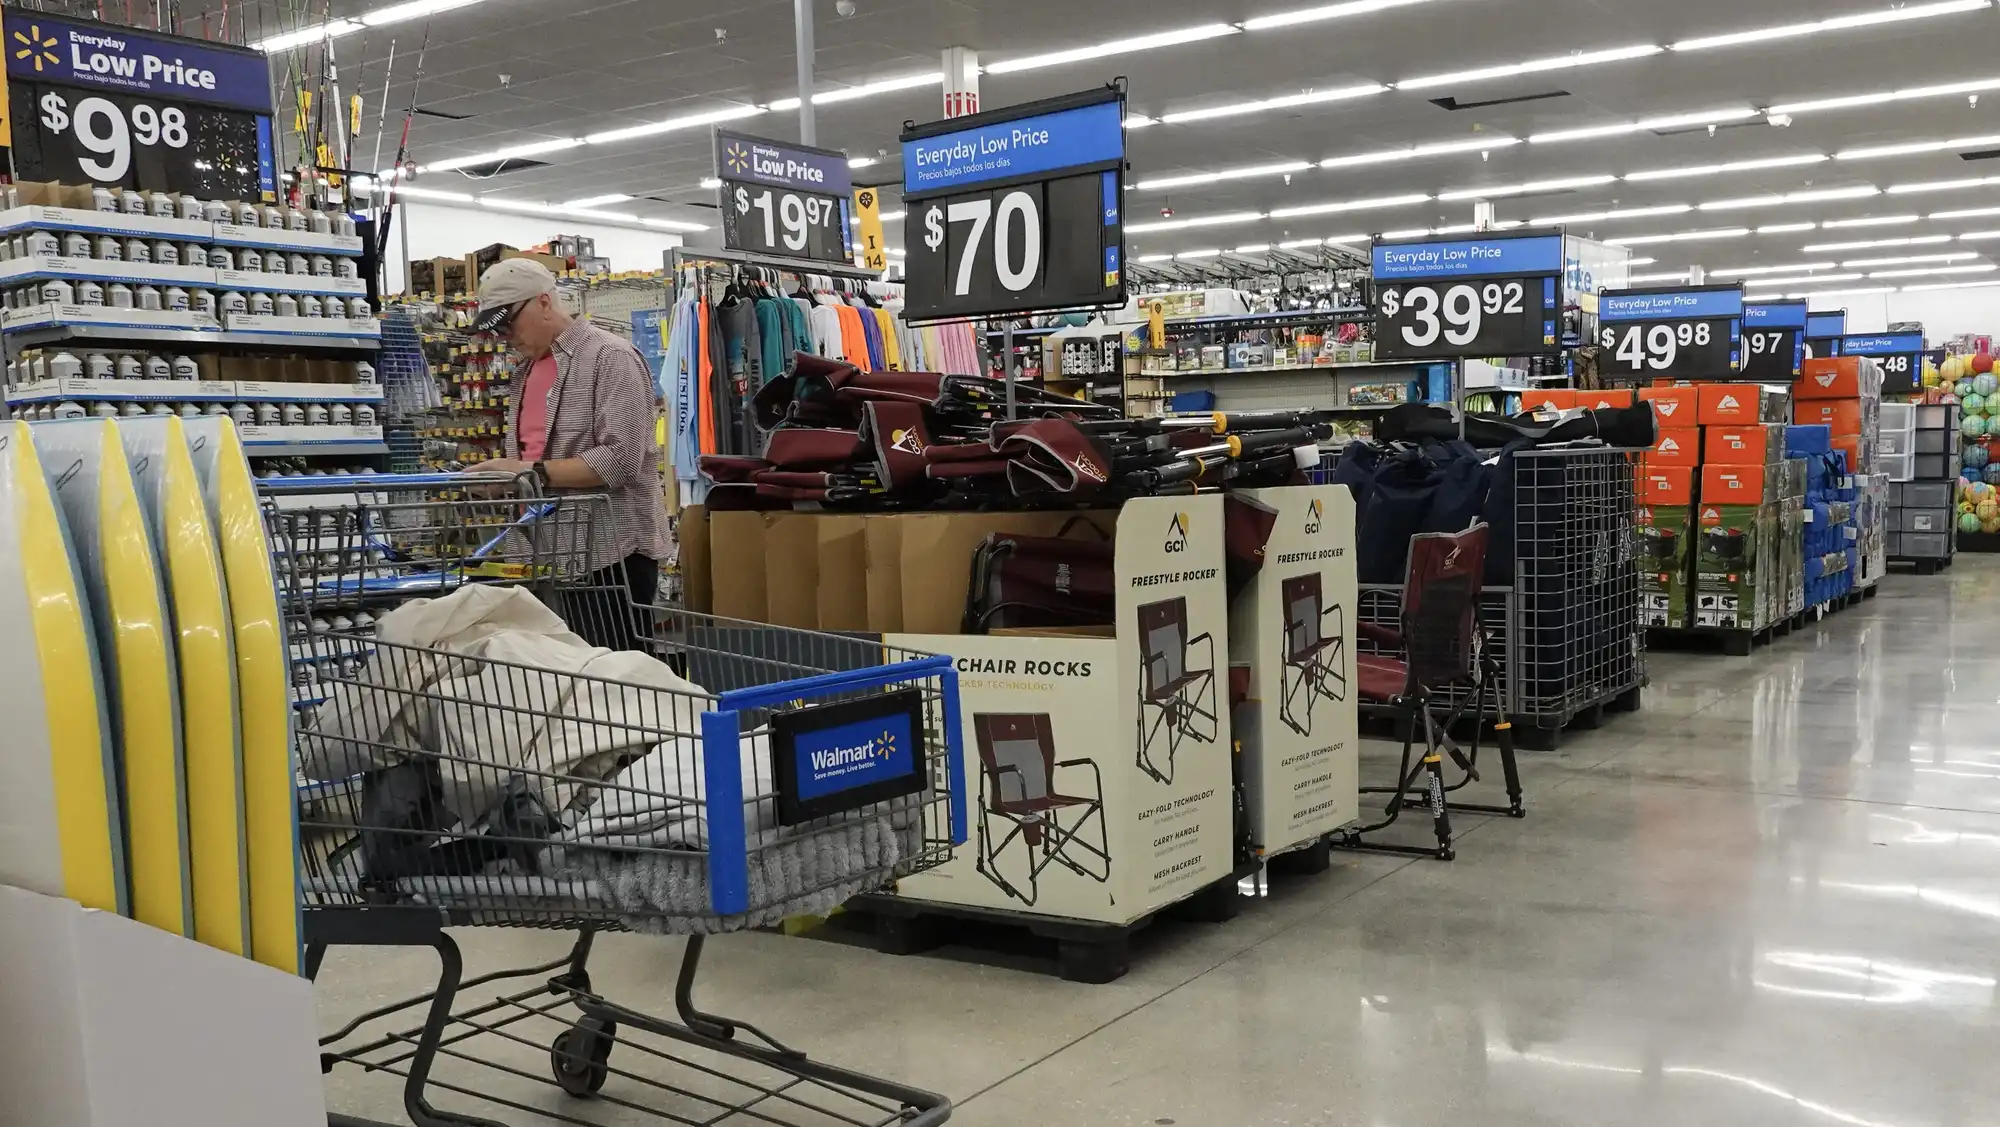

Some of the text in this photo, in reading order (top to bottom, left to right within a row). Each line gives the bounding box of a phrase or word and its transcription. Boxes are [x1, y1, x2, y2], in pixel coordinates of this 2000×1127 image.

[69, 31, 126, 51] Everyday
[71, 43, 216, 90] Low Price
[753, 146, 780, 159] Everyday
[916, 127, 1049, 166] Everyday Low Price
[753, 154, 785, 177] Low
[787, 160, 824, 183] Price
[918, 170, 943, 181] Precios
[944, 168, 962, 178] bajos
[963, 164, 983, 174] todos
[984, 160, 996, 170] los
[1106, 208, 1118, 218] GM
[923, 190, 1041, 297] $70
[866, 254, 883, 269] 14
[1385, 246, 1502, 265] Everyday Low Price
[1408, 264, 1425, 273] bajos
[1426, 263, 1444, 271] todos
[1608, 296, 1697, 310] Everyday Low Price
[1745, 308, 1767, 317] Price
[1304, 523, 1319, 535] GCI
[1164, 540, 1184, 554] GCI
[1277, 551, 1317, 564] FREESTYLE
[1131, 572, 1180, 588] FREESTYLE
[957, 657, 1092, 677] CHAIR ROCKS
[987, 679, 1056, 692] TECHNOLOGY
[811, 739, 875, 771] Walmart
[1281, 752, 1310, 767] EAZY-FOLD
[1311, 742, 1344, 757] TECHNOLOGY
[814, 760, 877, 781] Save money. Live better.
[1293, 772, 1333, 791] CARRY HANDLE
[1138, 802, 1172, 821] EAZY-FOLD
[1174, 788, 1215, 808] TECHNOLOGY
[1293, 808, 1308, 821] MESH
[1308, 799, 1334, 815] BACKREST
[1153, 824, 1200, 847] CARRY HANDLE
[1153, 868, 1170, 881] MESH
[1171, 854, 1203, 873] BACKREST
